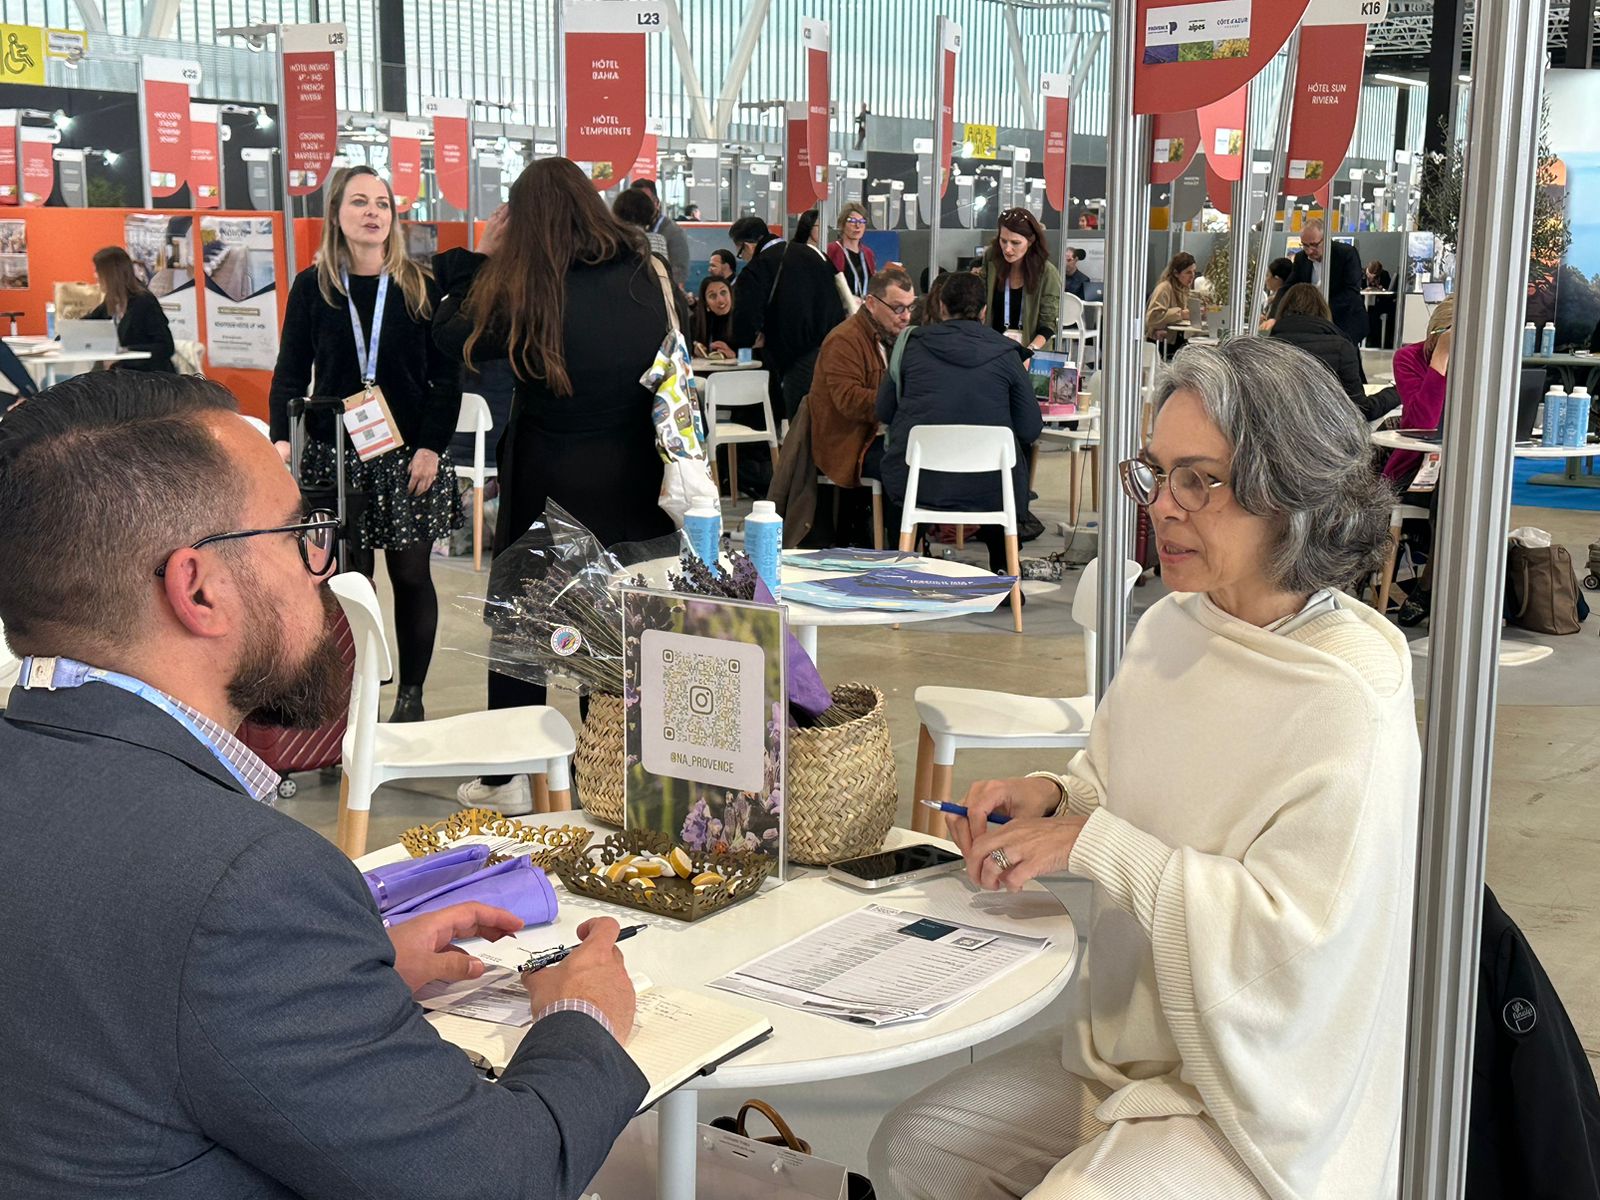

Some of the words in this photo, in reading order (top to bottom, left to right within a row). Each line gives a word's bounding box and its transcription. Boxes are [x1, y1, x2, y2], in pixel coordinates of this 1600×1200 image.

[1361, 2, 1381, 16] K16
[637, 13, 660, 25] L23
[1188, 24, 1206, 32] alpes
[592, 59, 620, 69] HÔTEL
[592, 71, 620, 80] BAHIA
[1307, 82, 1330, 94] HÔTEL
[1331, 82, 1347, 93] SUN
[1311, 95, 1339, 105] RIVIERA
[592, 115, 619, 125] HÔTEL
[580, 126, 632, 136] L'EMPREINTE
[670, 752, 735, 773] @NA_PROVENCE
